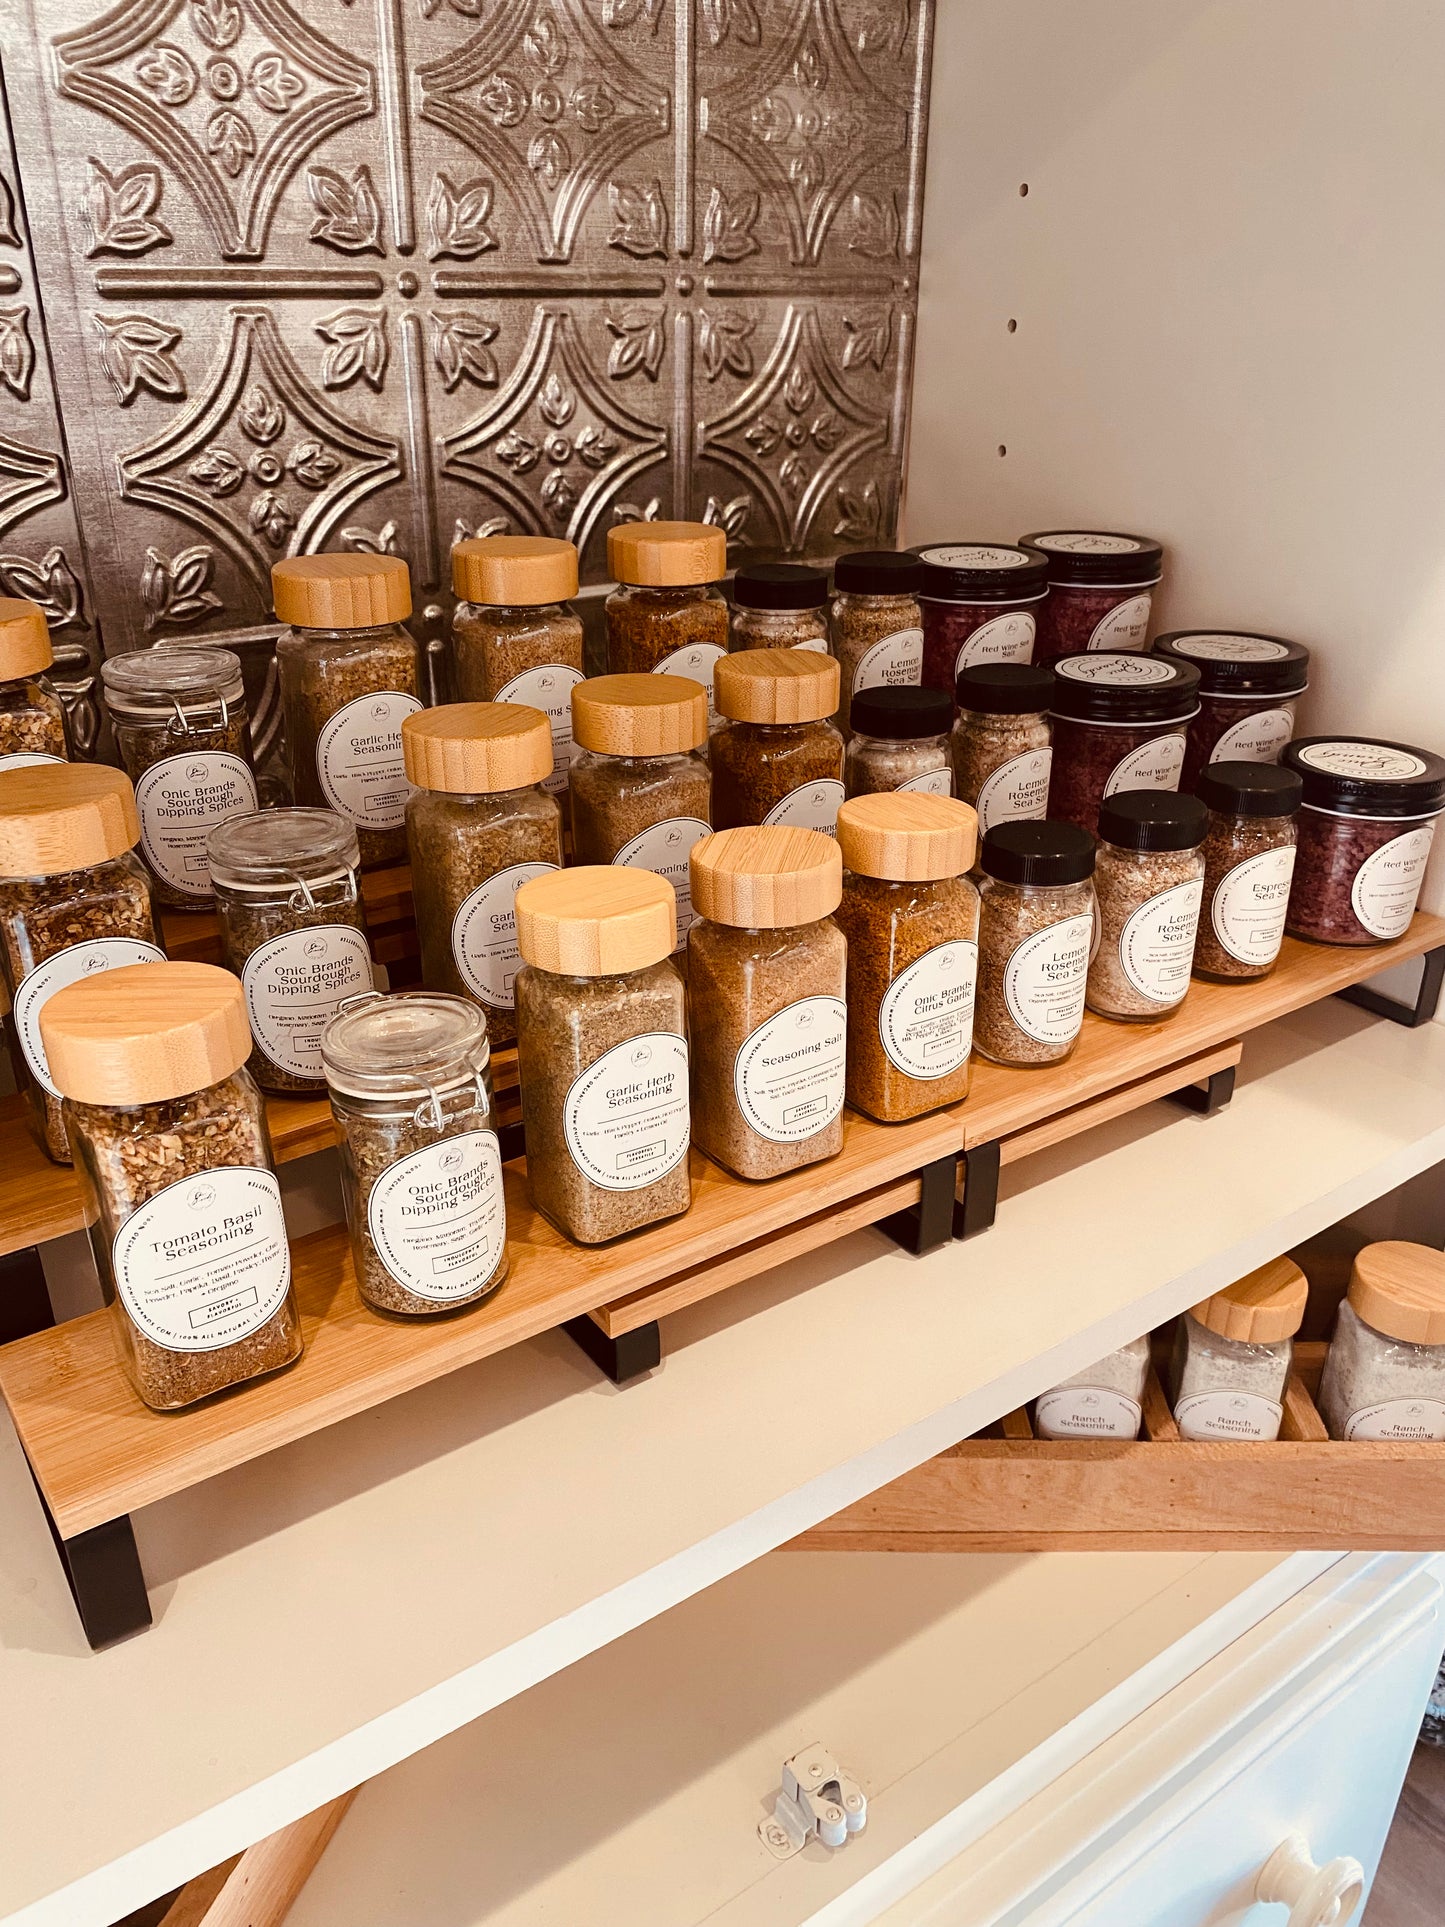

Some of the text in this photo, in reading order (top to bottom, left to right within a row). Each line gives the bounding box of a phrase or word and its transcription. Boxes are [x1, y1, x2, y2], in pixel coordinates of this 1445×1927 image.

[1001, 643, 1016, 652] Wine
[886, 676, 904, 685] Sea
[351, 736, 383, 747] Garlic
[354, 742, 402, 755] Seasoni
[162, 781, 235, 799] Onic Brands
[157, 796, 243, 818] Dipping Spices
[167, 791, 233, 808] Sourdough
[813, 825, 836, 838] Brand
[1403, 857, 1419, 867] Wine
[491, 911, 515, 924] Garl
[275, 956, 353, 976] Onic Brands
[268, 972, 360, 995] Dipping Spices
[281, 967, 350, 985] Sourdough
[915, 981, 972, 1006] Onic Brands
[915, 989, 971, 1015] Citrus Garlic
[762, 1034, 842, 1067] Seasoning Salt
[606, 1073, 675, 1099] Garlic Herb
[609, 1083, 673, 1108] Seasoning
[409, 1160, 488, 1196] Onic Brands
[401, 1174, 495, 1216] Dipping Spices
[416, 1172, 486, 1204] Sourdough
[150, 1205, 262, 1253] Tomato Basil
[165, 1222, 254, 1261] Seasoning
[1060, 1420, 1115, 1430] Seasoning
[1205, 1421, 1261, 1435] Seasoning
[1218, 1416, 1251, 1428] Ranch
[1380, 1430, 1434, 1439] Seasoning
